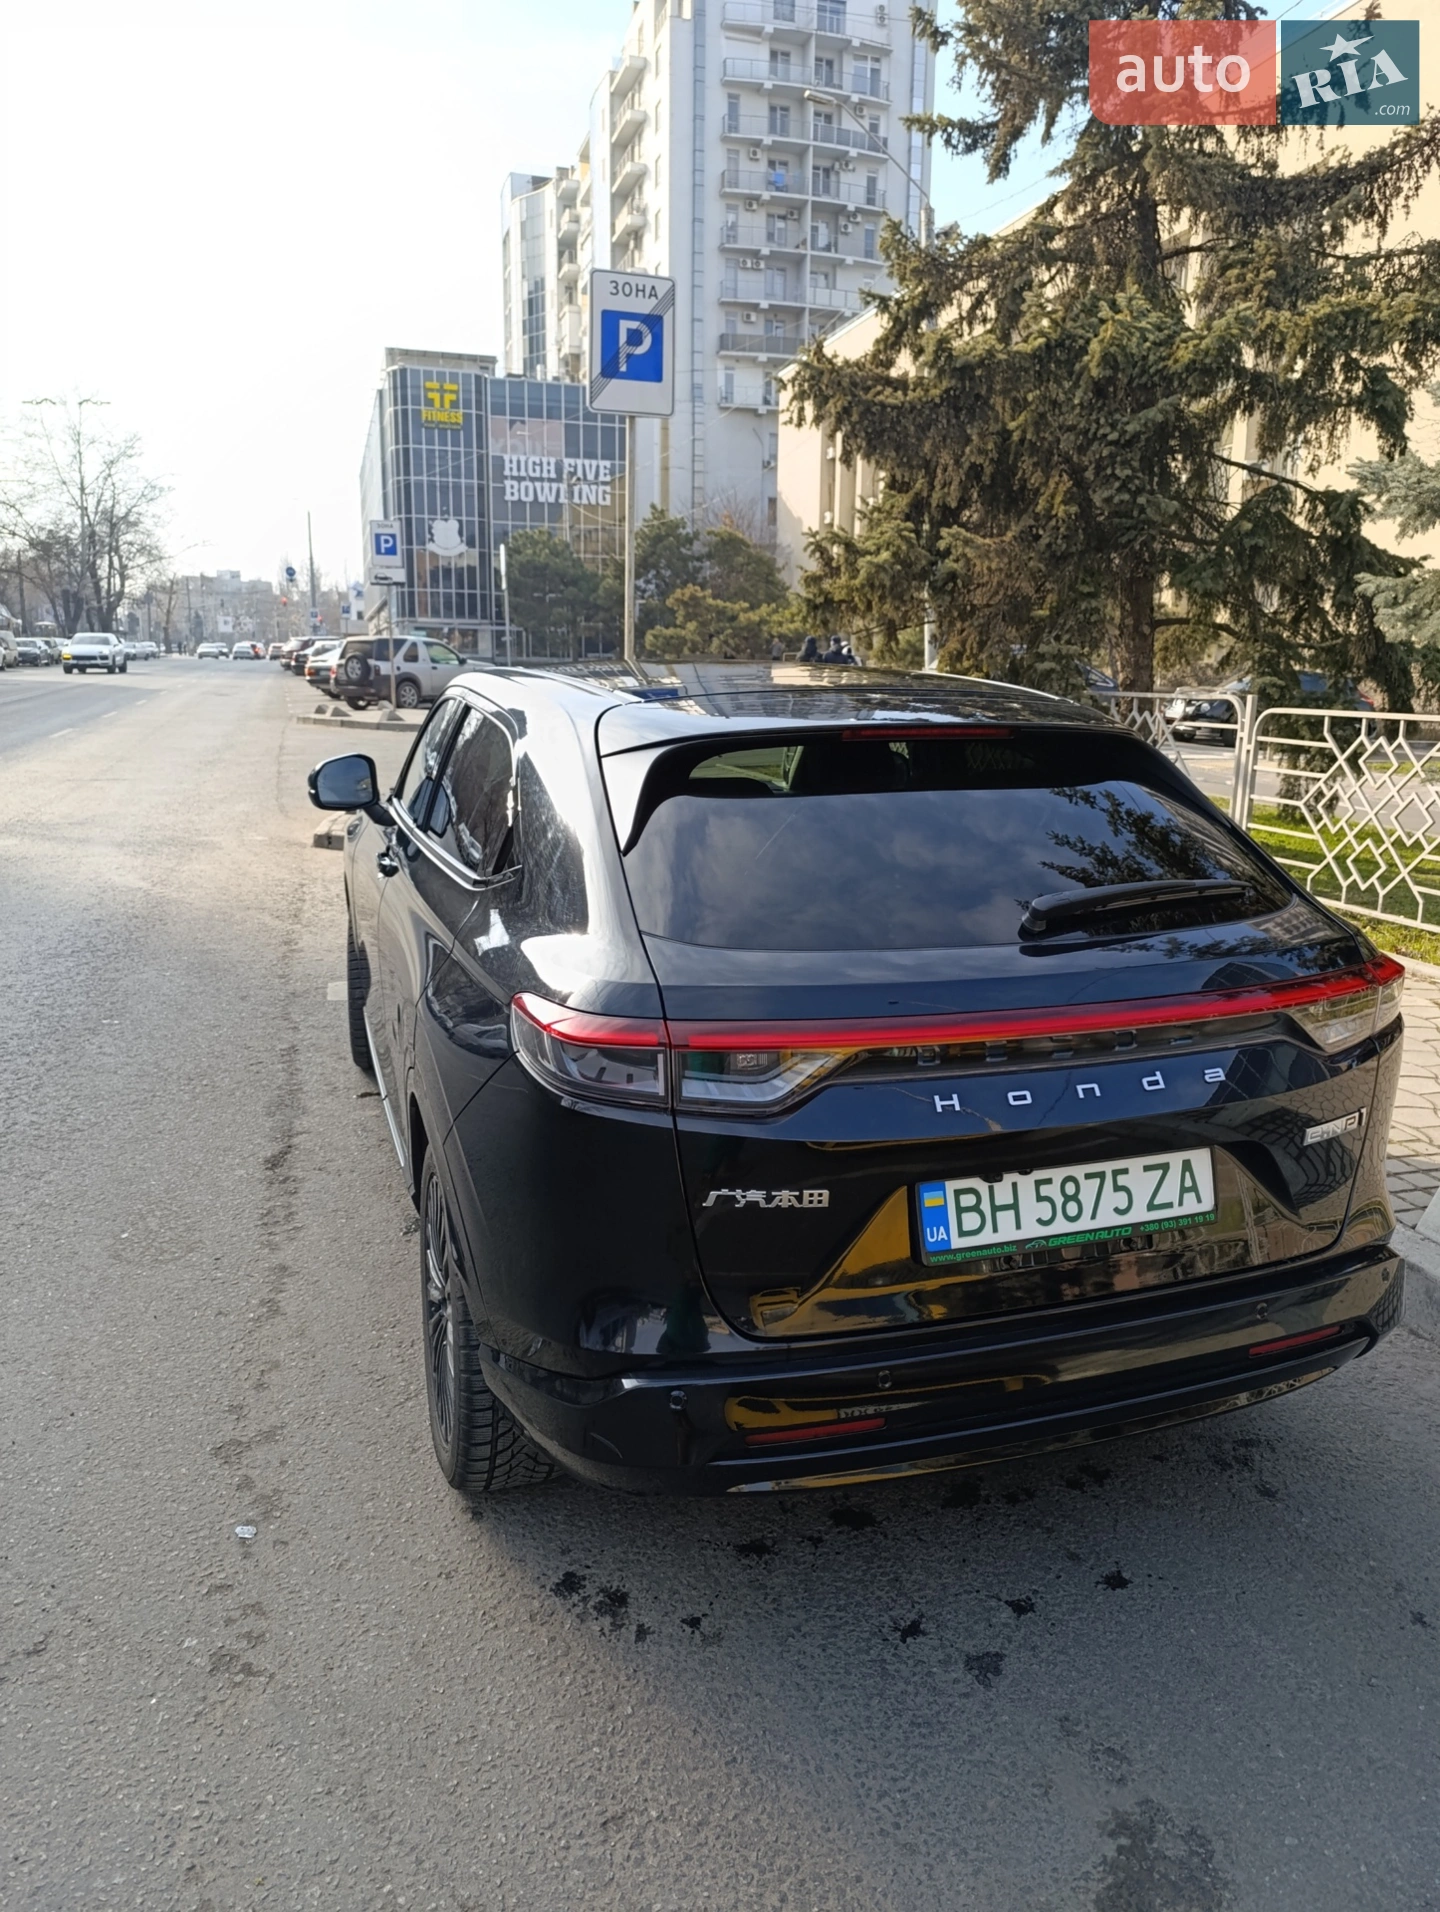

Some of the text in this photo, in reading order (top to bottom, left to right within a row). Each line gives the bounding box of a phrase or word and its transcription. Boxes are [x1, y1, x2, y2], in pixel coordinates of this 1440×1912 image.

[609, 280, 659, 300] ЗОНА
[619, 319, 652, 372] P
[422, 410, 462, 424] FITNESS
[503, 455, 611, 482] HIGH FIVE
[504, 480, 611, 506] BOWLING
[381, 535, 394, 553] P
[702, 1189, 829, 1208] 广汽本田
[953, 1158, 1203, 1239] BH 5875 ZA
[926, 1226, 948, 1242] UA
[930, 1245, 1017, 1262] www.greenauto.biz
[1139, 1222, 1160, 1233] +380
[1161, 1218, 1177, 1231] (93)
[1178, 1217, 1192, 1228] 391
[1194, 1215, 1204, 1224] 19
[1205, 1213, 1215, 1222] 19
